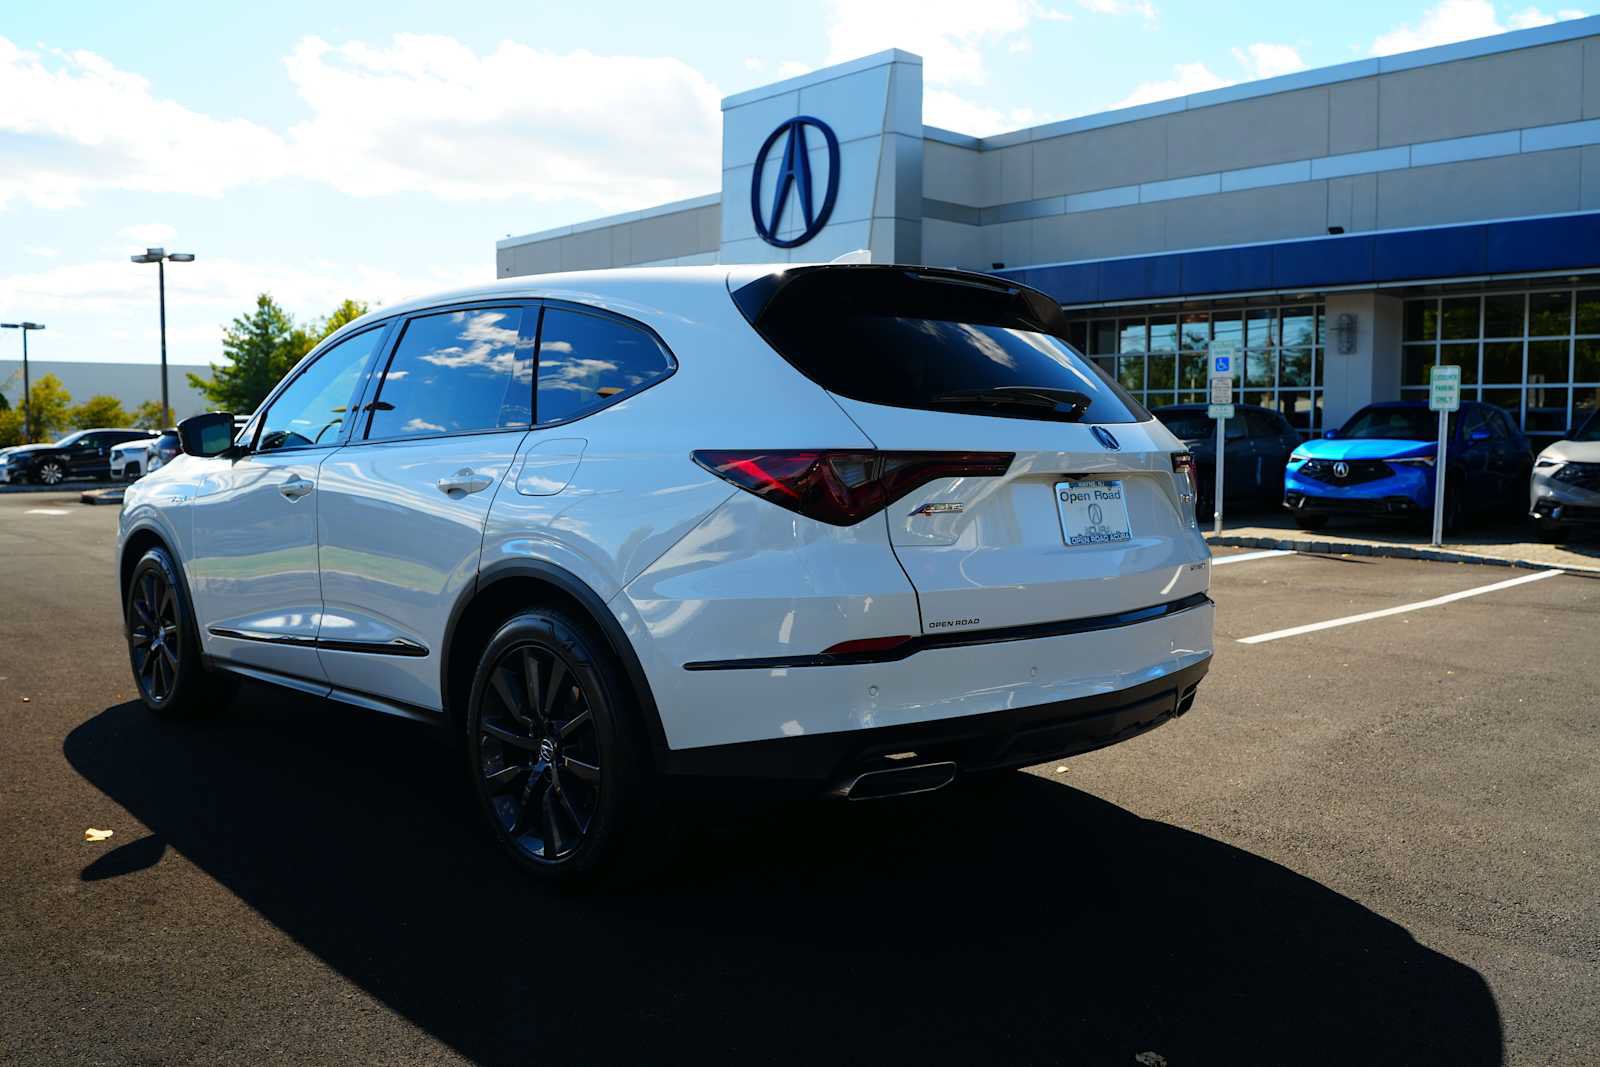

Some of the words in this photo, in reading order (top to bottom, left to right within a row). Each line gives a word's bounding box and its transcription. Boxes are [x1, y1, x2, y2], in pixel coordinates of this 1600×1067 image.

[1060, 491, 1090, 504] Open
[1094, 489, 1120, 500] Road
[1071, 536, 1090, 544] OPEN
[1091, 534, 1109, 543] ROAD
[928, 620, 954, 629] OPEN
[955, 618, 980, 626] ROAD
